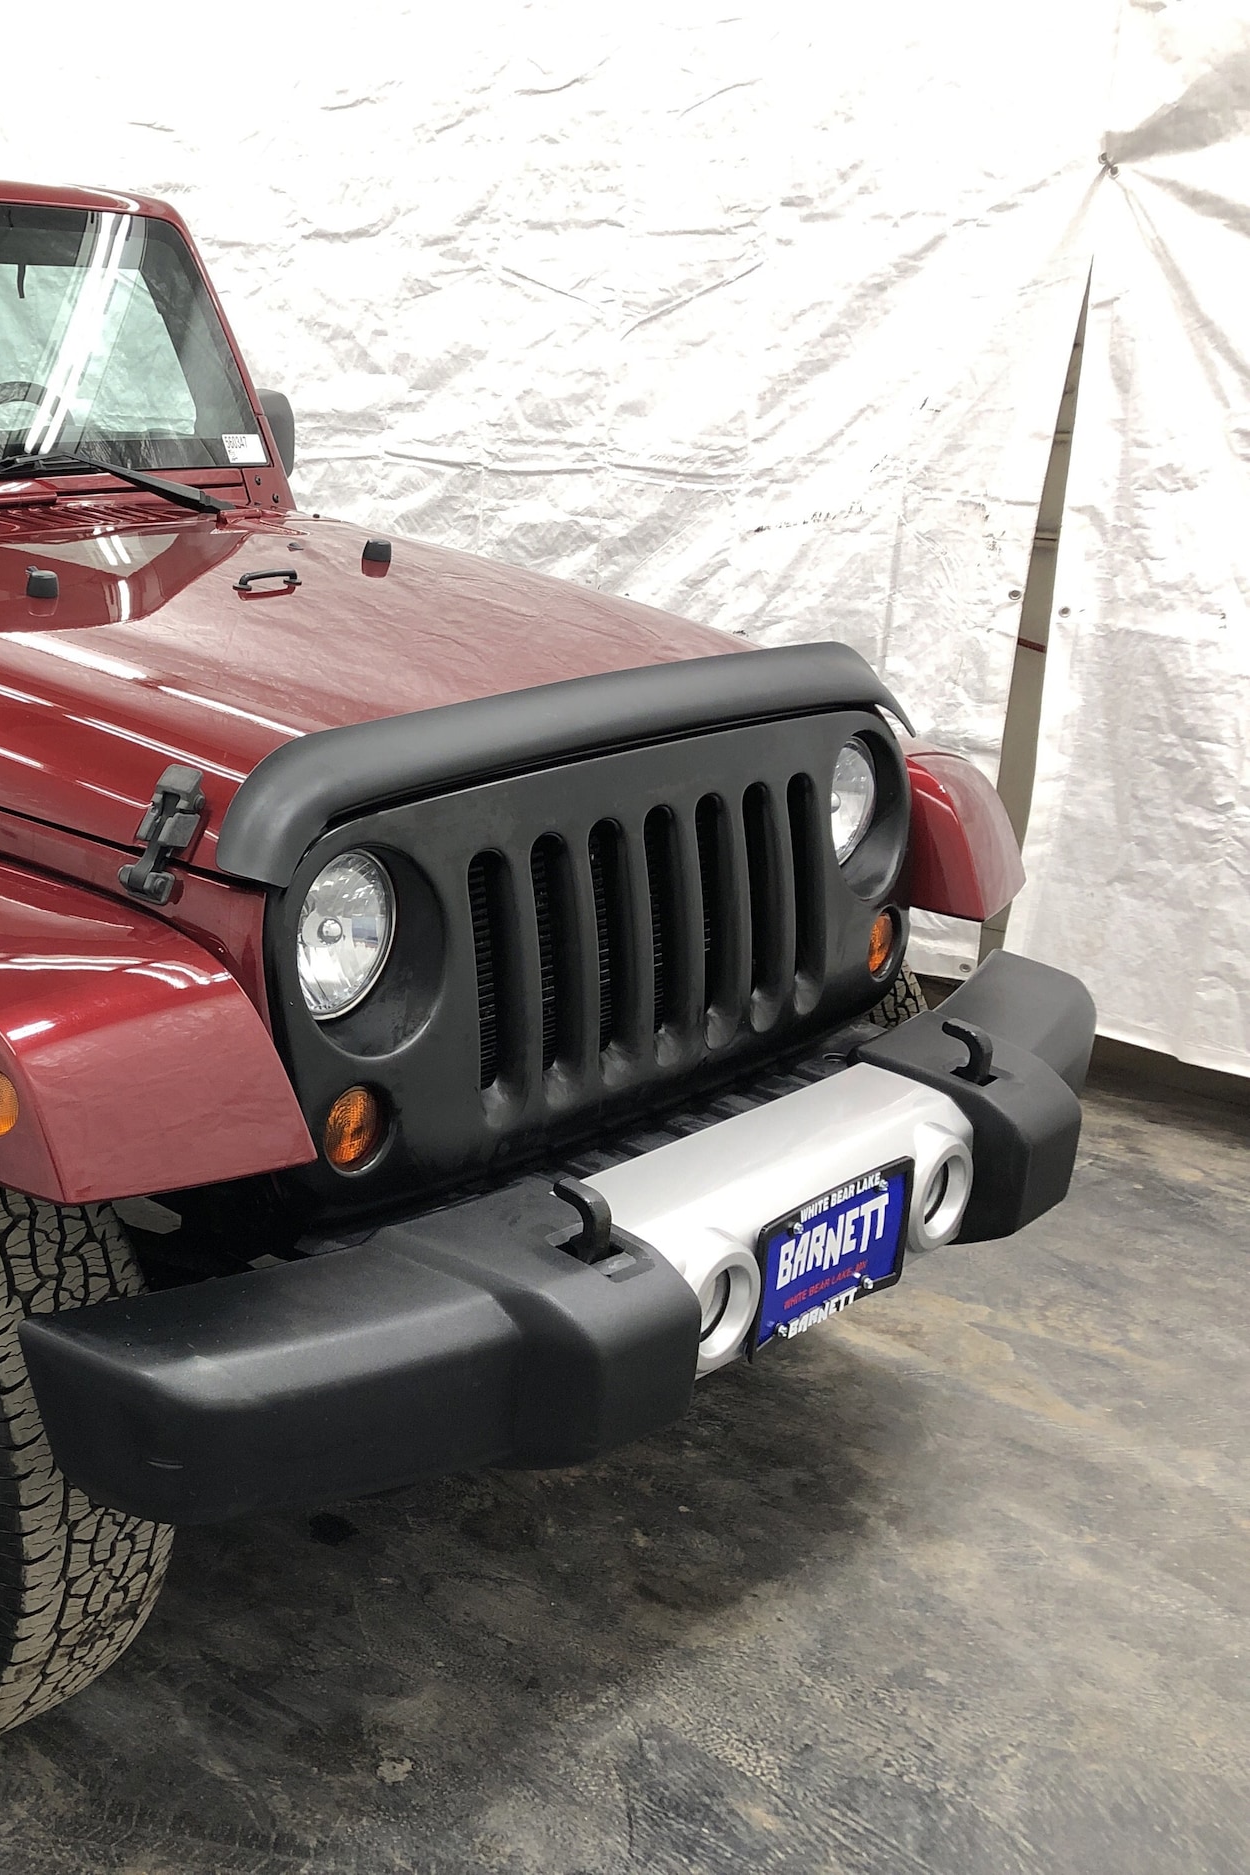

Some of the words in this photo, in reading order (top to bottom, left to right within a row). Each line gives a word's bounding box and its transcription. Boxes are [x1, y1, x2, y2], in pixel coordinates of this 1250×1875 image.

[800, 1197, 830, 1224] WHITE
[830, 1184, 855, 1208] BEAR
[855, 1171, 881, 1195] LAKE
[776, 1193, 889, 1290] BARNETT
[787, 1287, 857, 1340] BARNETT
